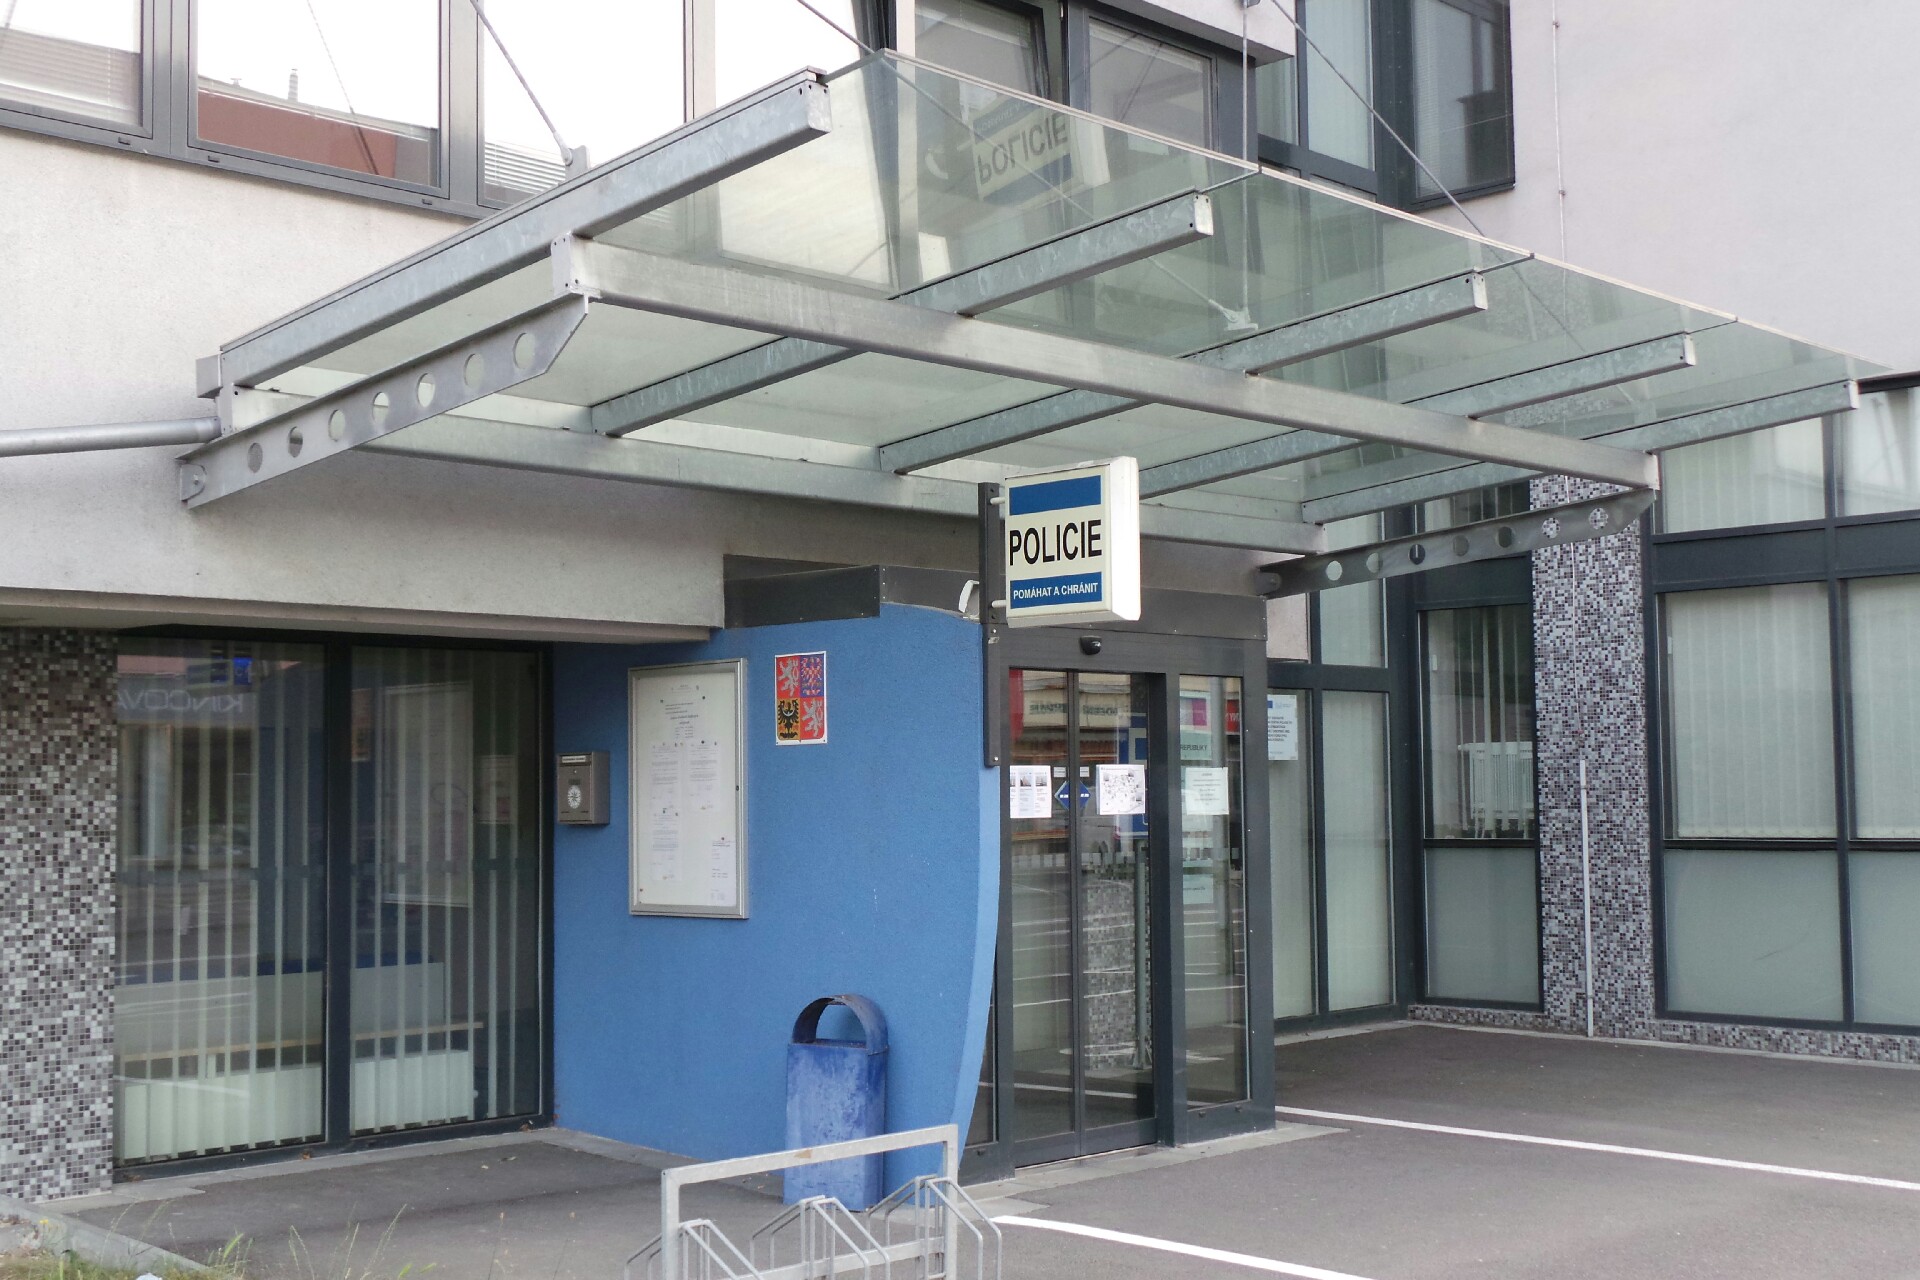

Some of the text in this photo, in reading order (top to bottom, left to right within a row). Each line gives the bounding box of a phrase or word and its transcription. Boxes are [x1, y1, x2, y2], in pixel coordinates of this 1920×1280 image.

[1009, 519, 1102, 566] POLICIE
[1013, 582, 1098, 600] POMÁHAT A CHRÁNIT
